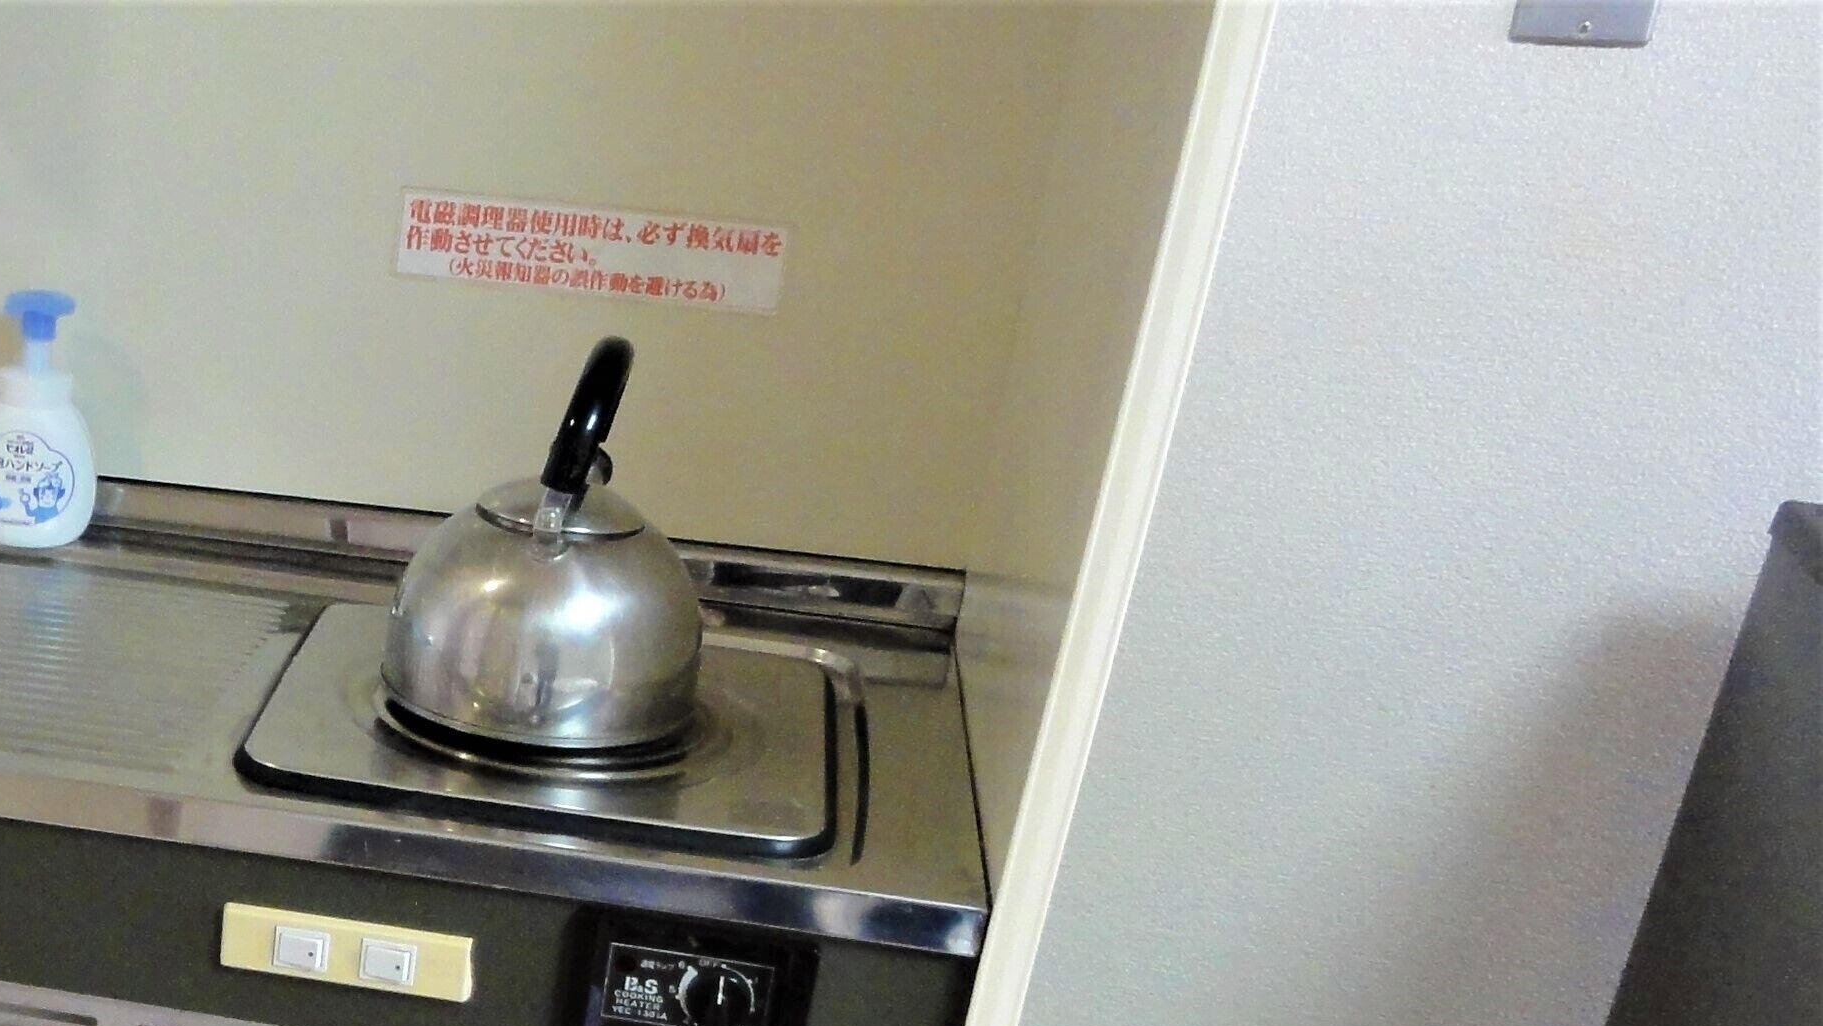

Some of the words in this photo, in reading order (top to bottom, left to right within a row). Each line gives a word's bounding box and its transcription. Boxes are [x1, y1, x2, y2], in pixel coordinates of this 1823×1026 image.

[410, 198, 782, 257] 電磁調理器使用時は、必ず換気扇を
[406, 225, 597, 266] 作動させてください。
[614, 989, 664, 1004] COOKING
[615, 998, 661, 1011] HEATER
